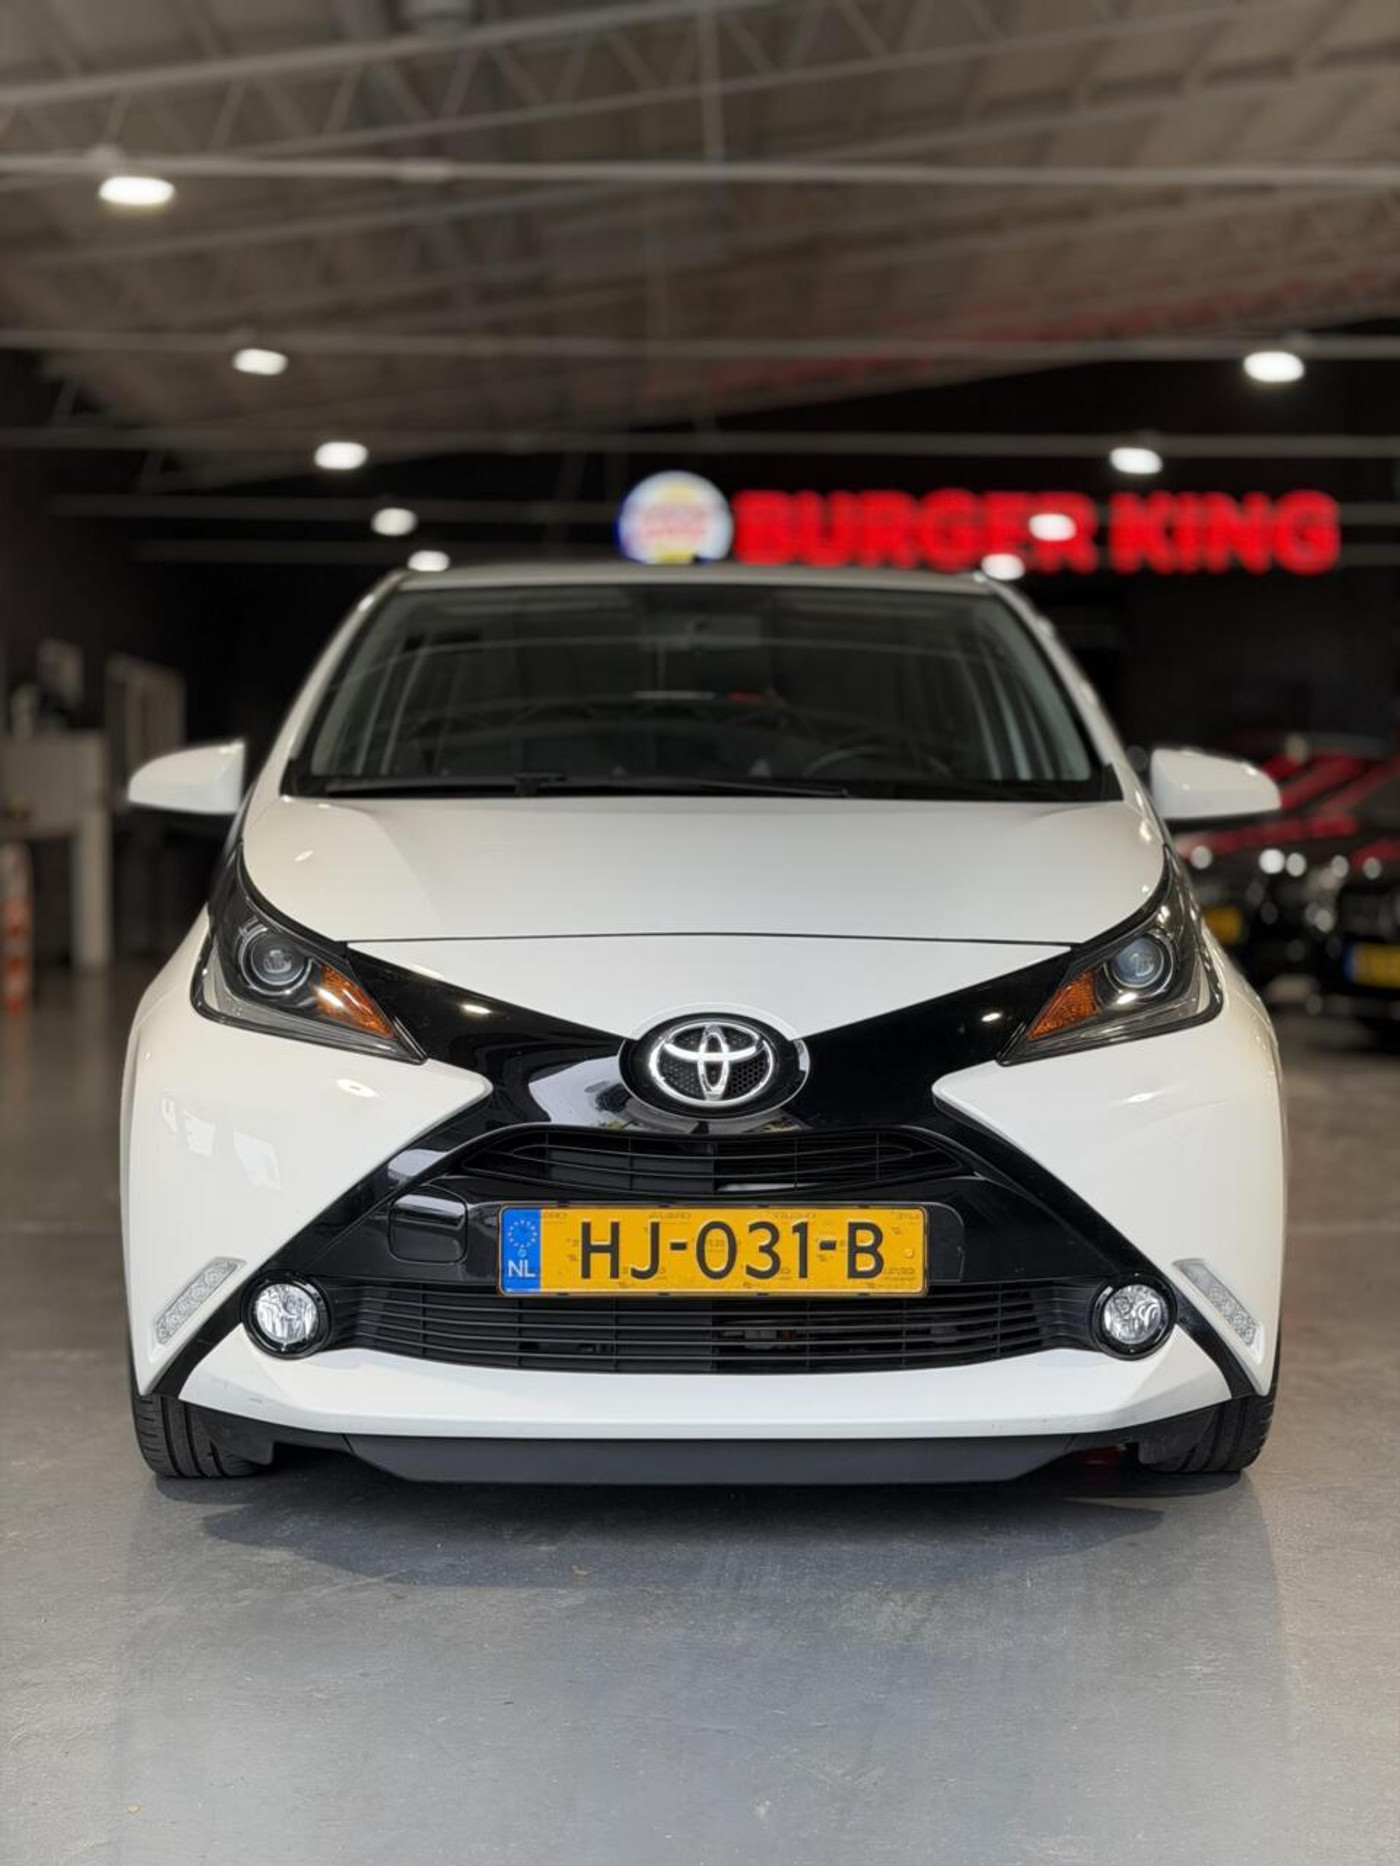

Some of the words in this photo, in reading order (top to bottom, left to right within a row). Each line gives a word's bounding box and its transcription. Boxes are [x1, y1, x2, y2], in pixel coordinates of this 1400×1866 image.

[733, 489, 1097, 572] BURGER
[1109, 490, 1341, 575] KING
[507, 1259, 537, 1278] NL
[580, 1220, 885, 1281] HJ-031-B
